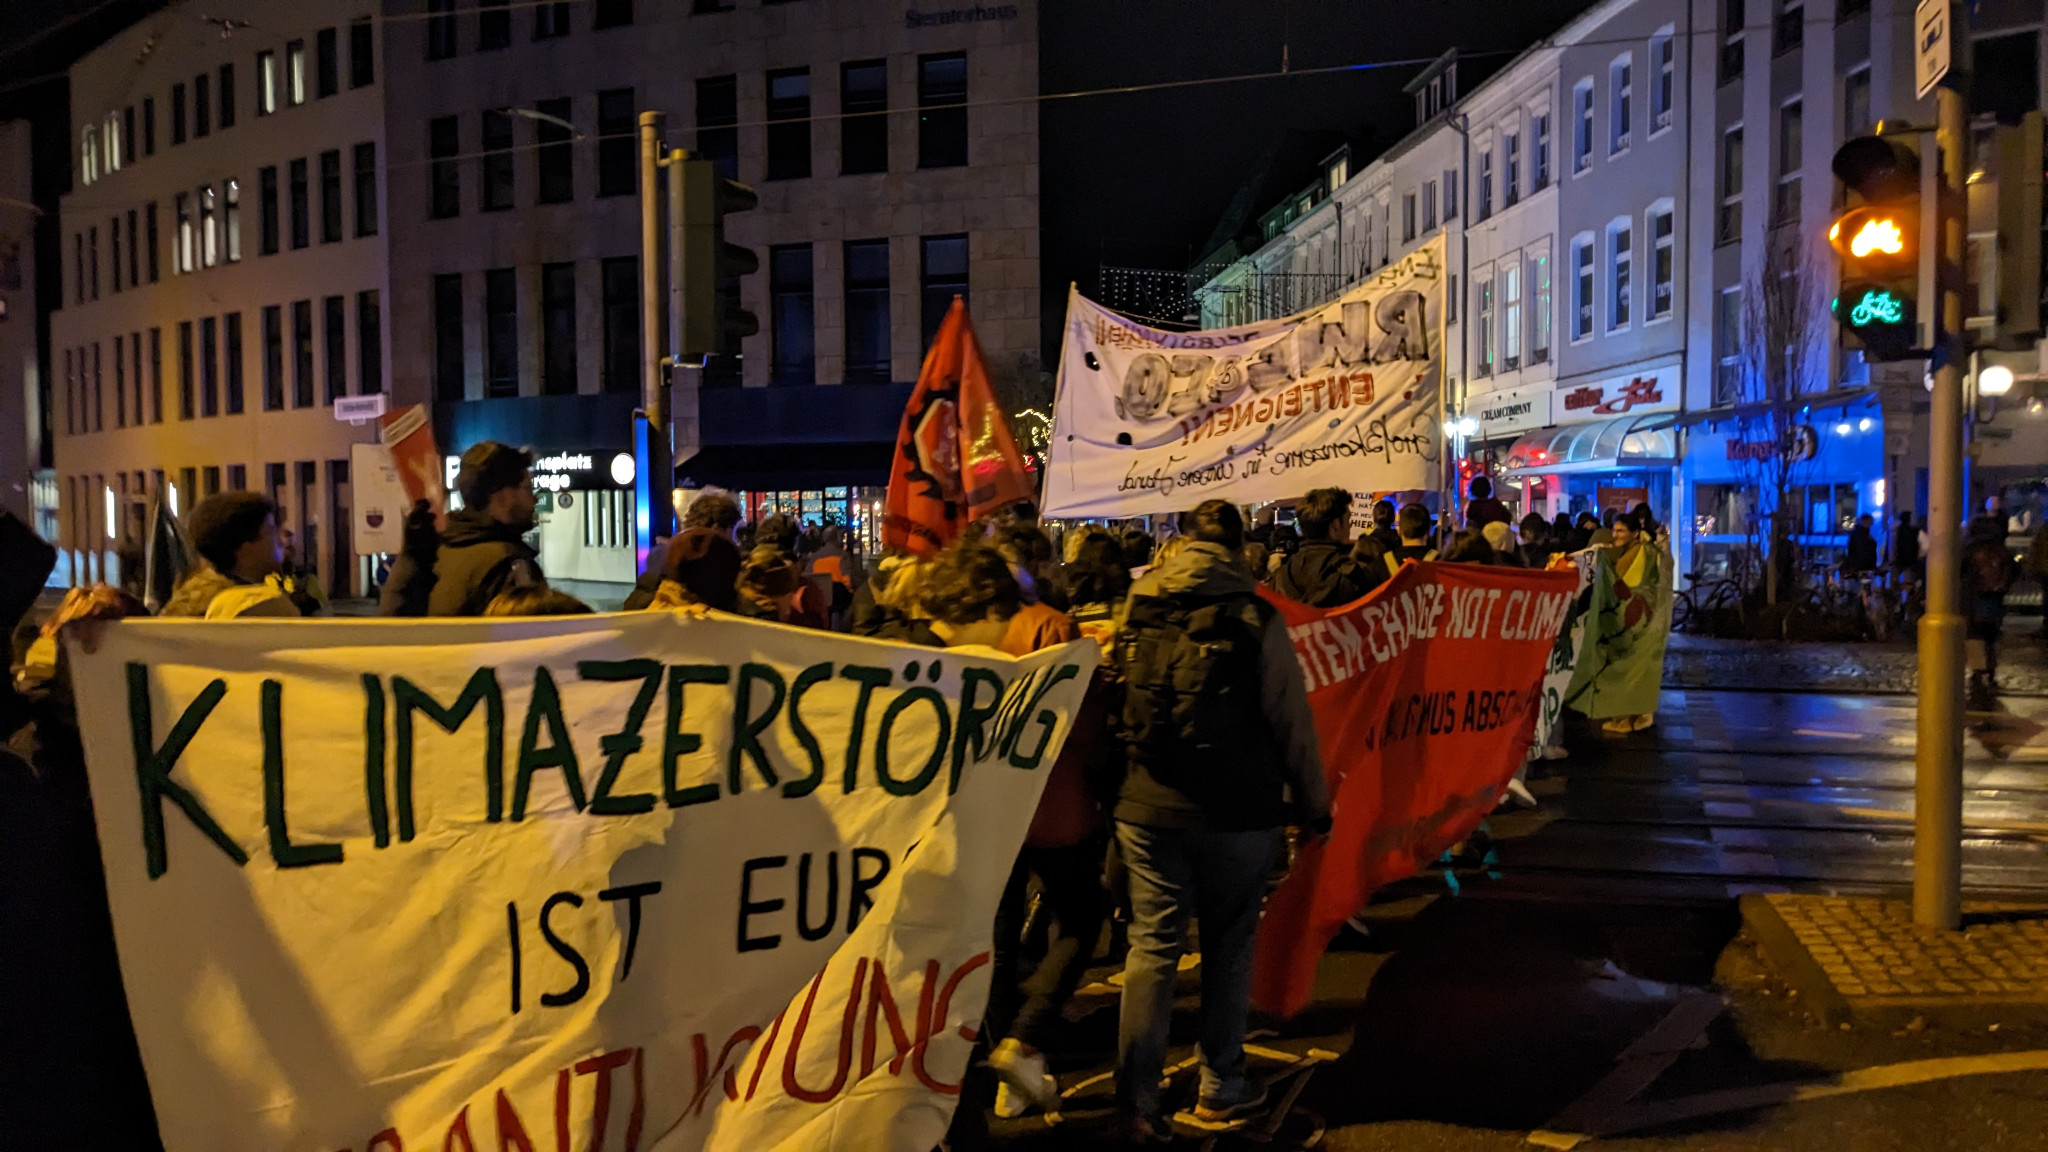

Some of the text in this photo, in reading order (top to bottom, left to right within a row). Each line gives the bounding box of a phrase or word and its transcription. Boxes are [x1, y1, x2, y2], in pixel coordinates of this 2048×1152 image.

[535, 451, 593, 473] nsplatz
[532, 474, 570, 492] rage
[1350, 519, 1374, 530] HIER
[1445, 586, 1502, 639] NOT
[1501, 589, 1573, 641] CLIMA
[506, 847, 890, 1014] IST EUR
